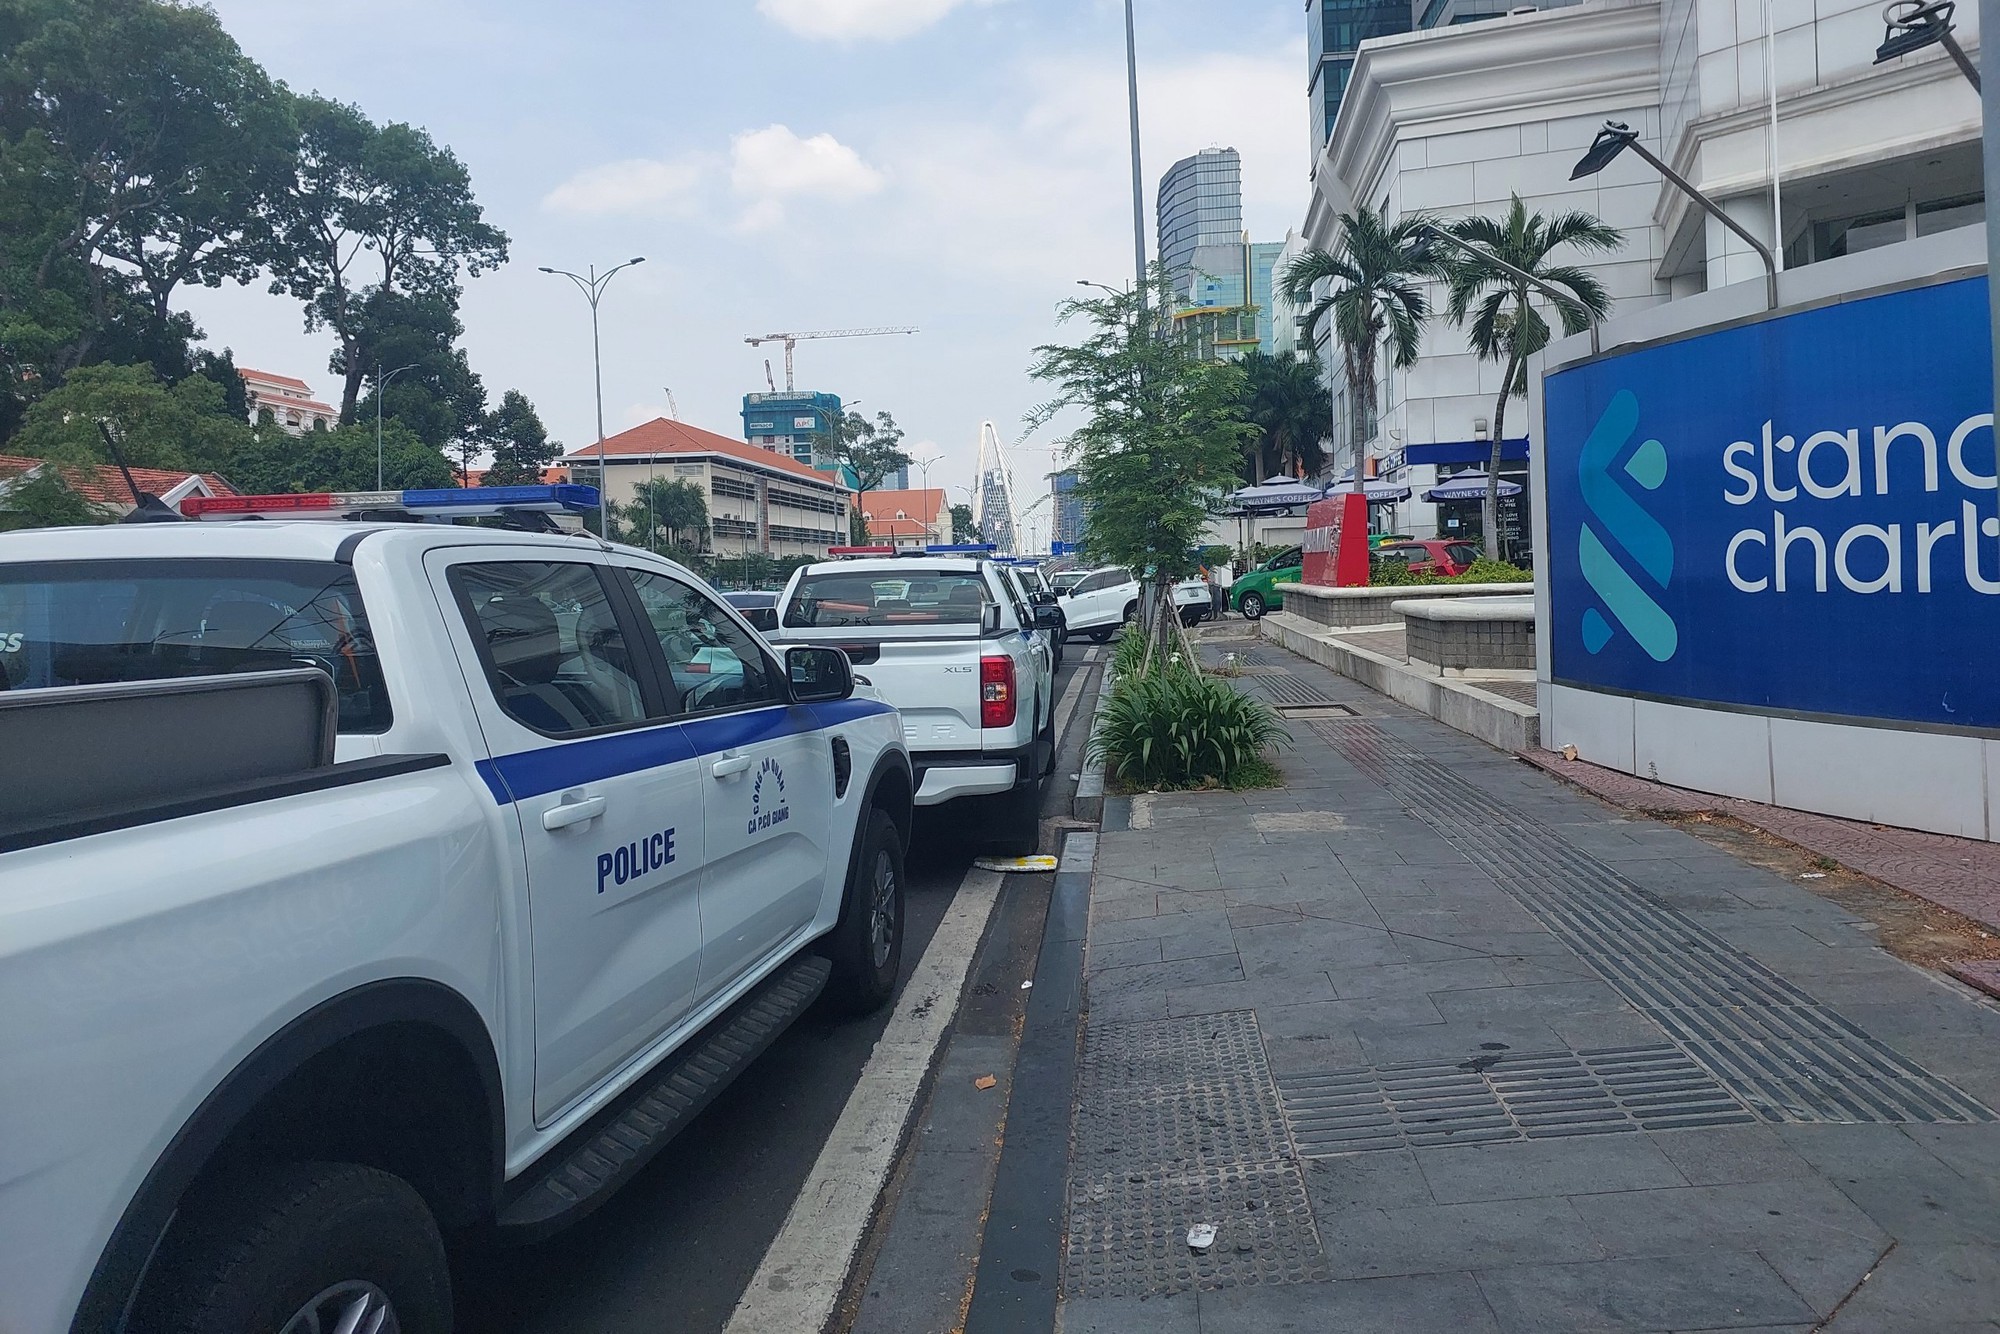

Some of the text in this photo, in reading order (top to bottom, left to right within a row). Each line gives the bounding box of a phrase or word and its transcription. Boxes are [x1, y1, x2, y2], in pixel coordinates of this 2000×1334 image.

[1368, 490, 1397, 499] COFFEE
[1443, 488, 1511, 498] WAYNE'S CFEE
[1247, 494, 1312, 505] WAYNE'S COFFEE
[748, 818, 757, 835] CA
[771, 806, 789, 825] GIANG
[597, 827, 676, 894] POLICE
